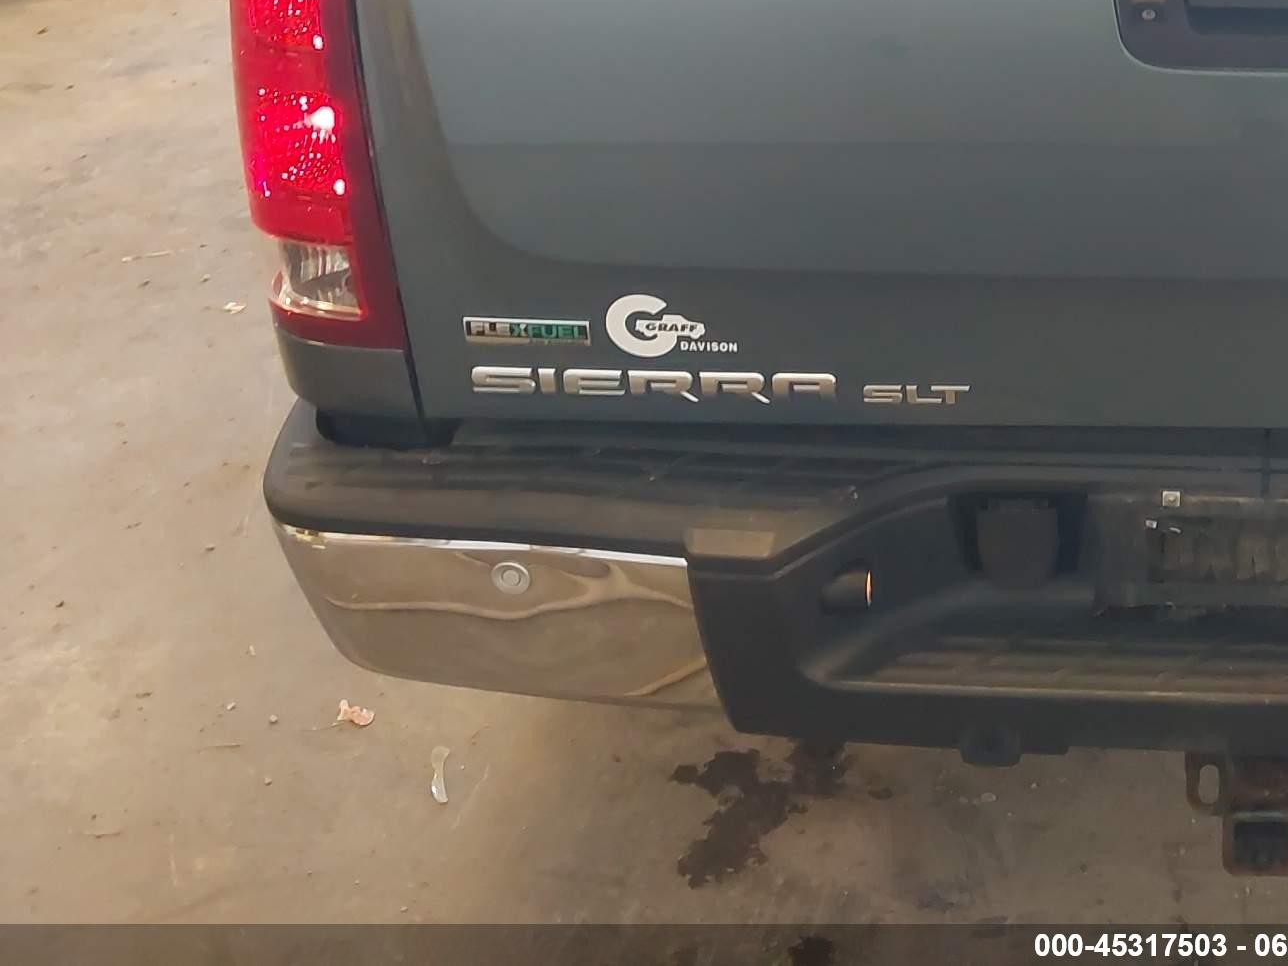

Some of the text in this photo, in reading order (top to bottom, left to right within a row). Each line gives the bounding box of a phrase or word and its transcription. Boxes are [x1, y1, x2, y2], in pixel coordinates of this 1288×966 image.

[645, 323, 699, 333] GRAFF
[680, 340, 738, 353] DAVISON
[471, 366, 971, 405] SIERRA SLT
